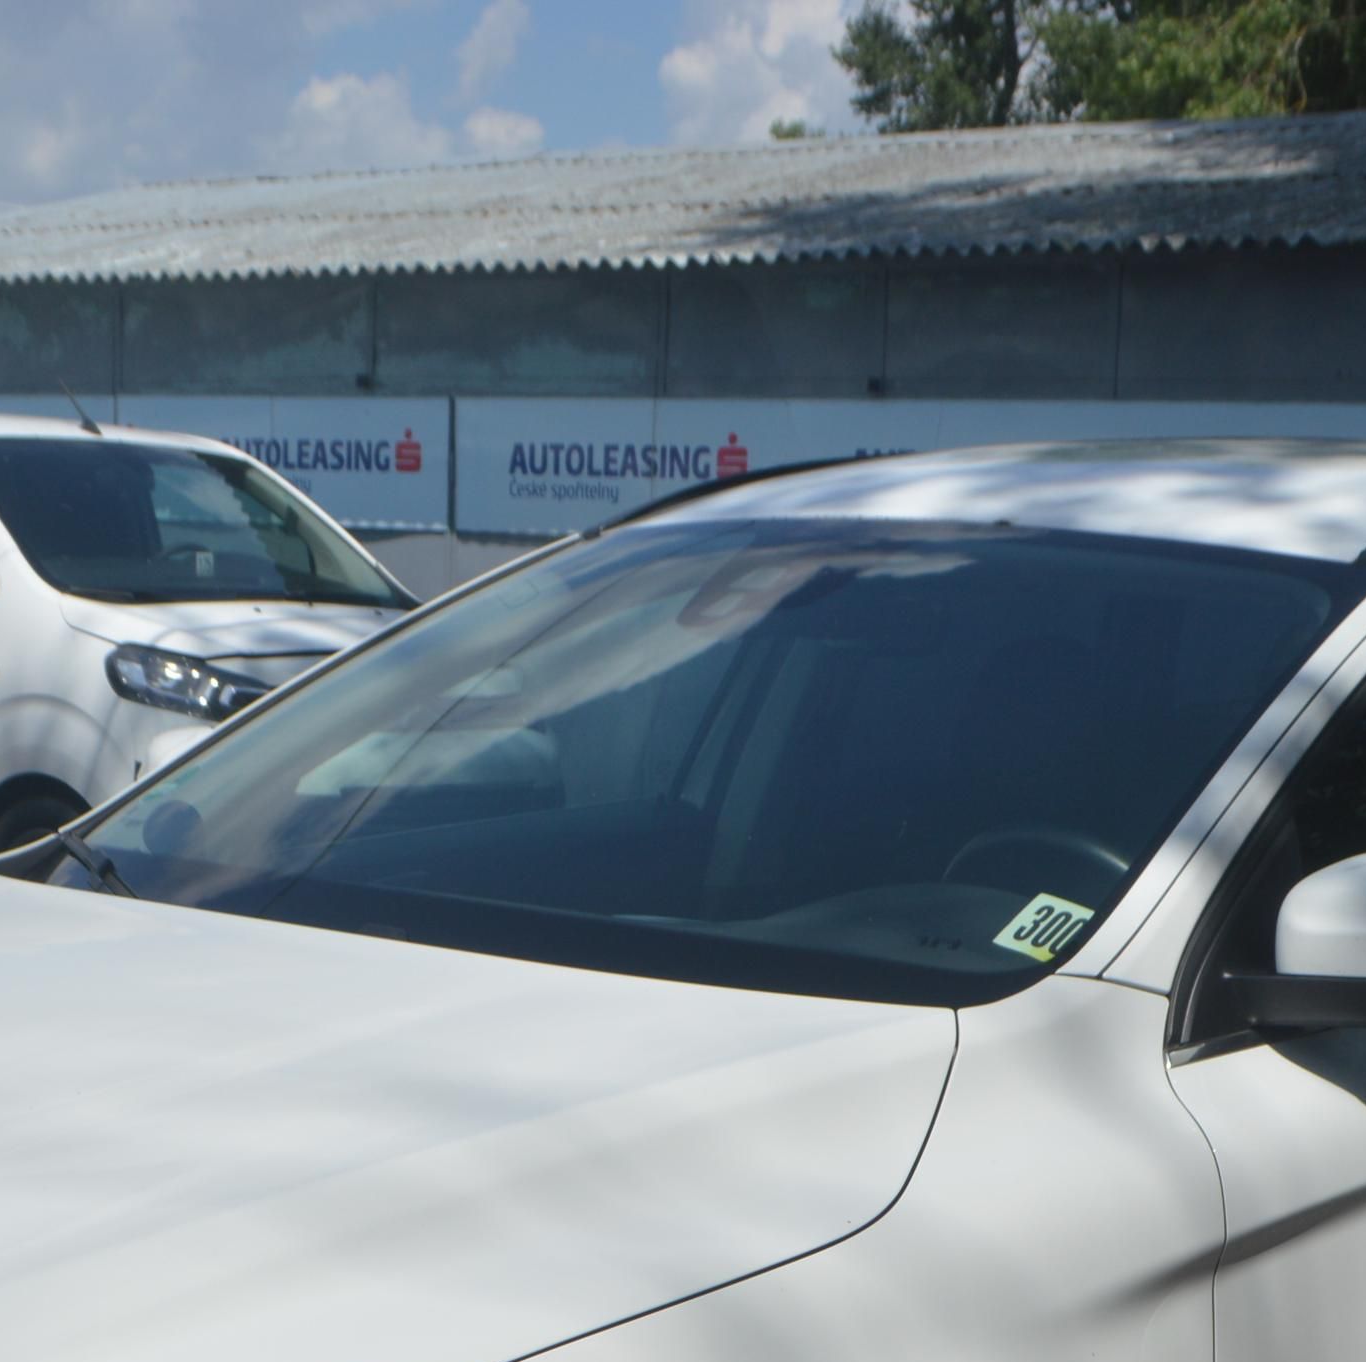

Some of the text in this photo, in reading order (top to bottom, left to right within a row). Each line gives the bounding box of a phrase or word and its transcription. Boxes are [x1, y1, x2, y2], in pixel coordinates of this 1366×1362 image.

[221, 438, 391, 472] TOLEASING
[509, 441, 711, 480] AUTOLEASING
[509, 478, 620, 503] České spořitelny
